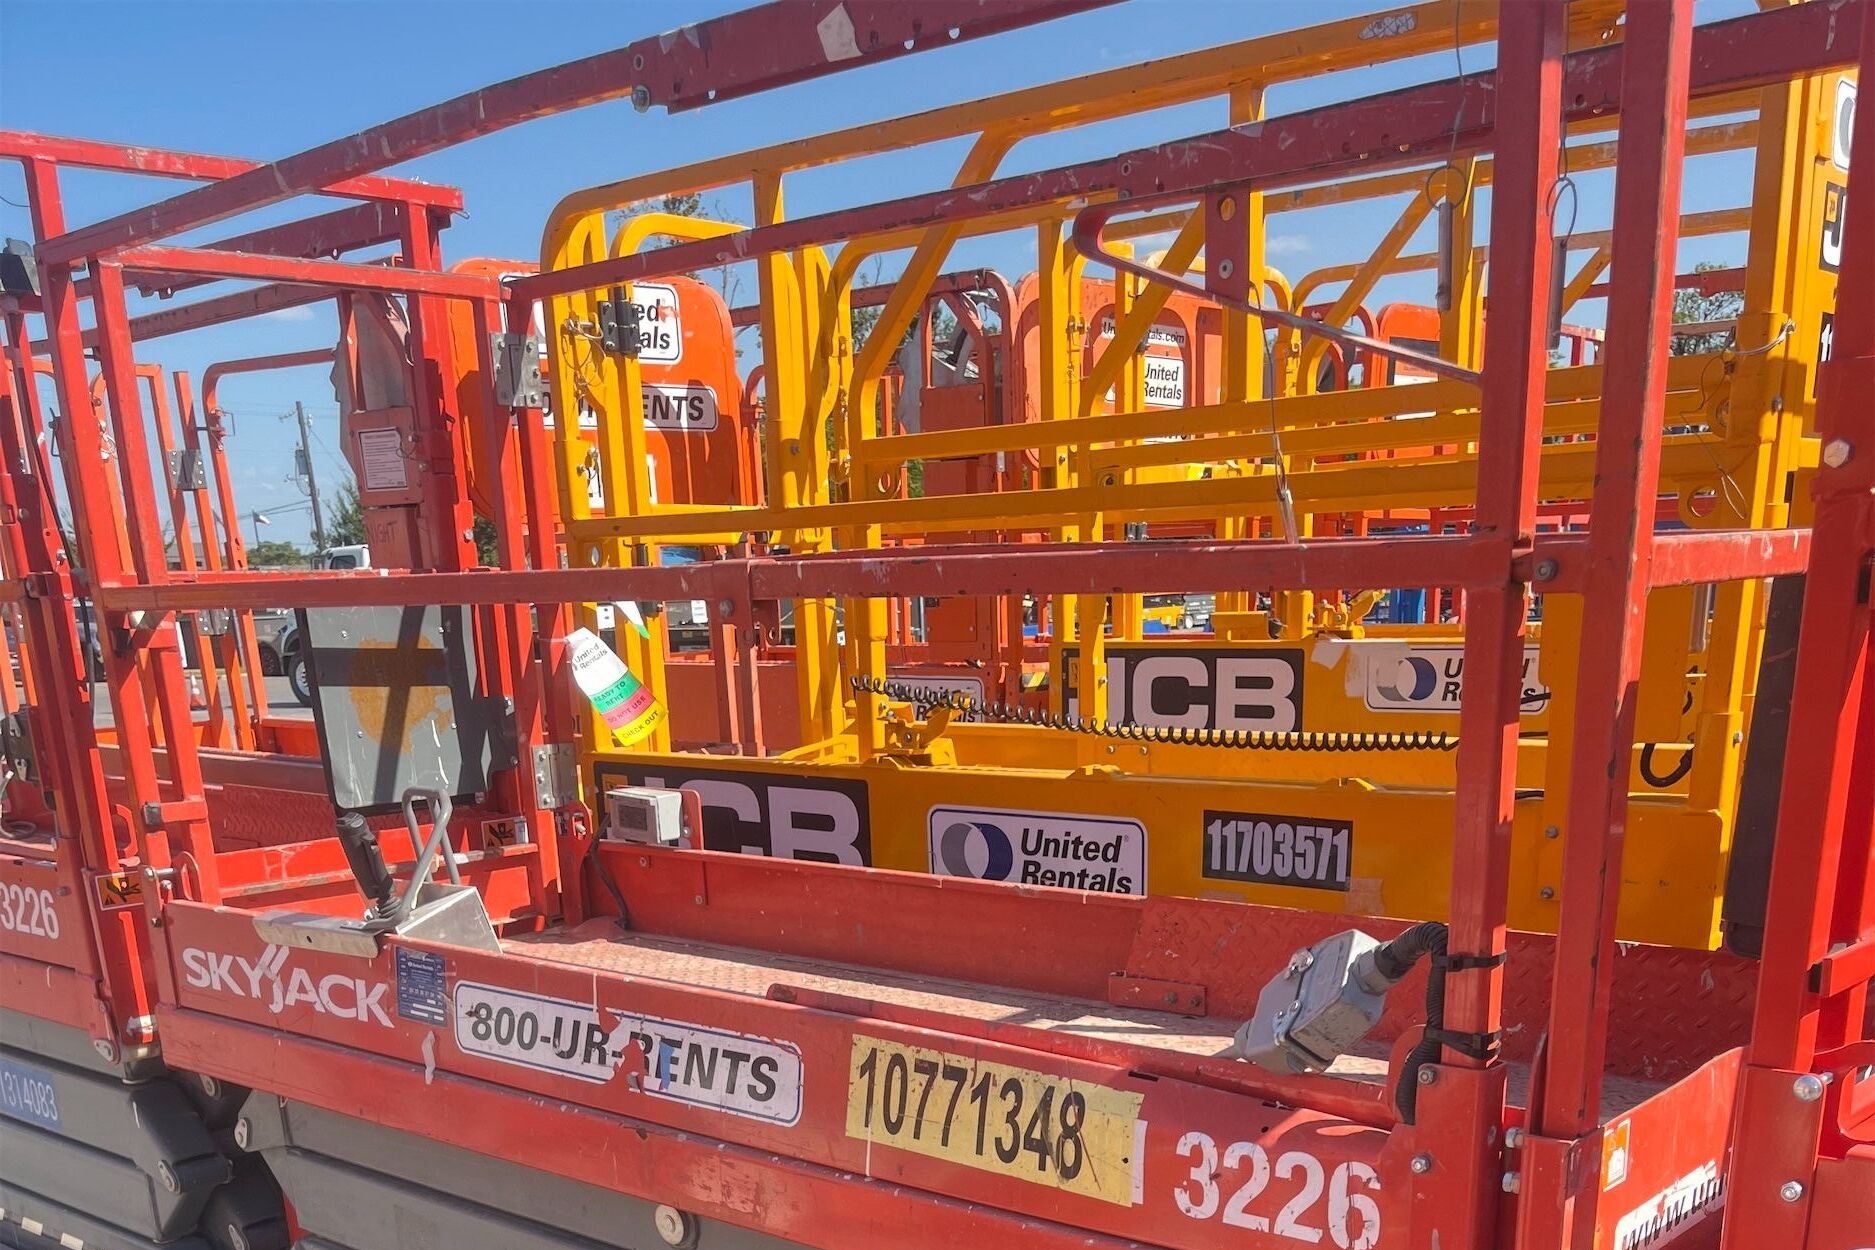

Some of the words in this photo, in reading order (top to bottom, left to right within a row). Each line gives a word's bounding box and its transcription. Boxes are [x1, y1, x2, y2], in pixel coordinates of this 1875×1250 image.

[1020, 828, 1121, 865] United
[1021, 860, 1132, 895] Rentals
[1206, 817, 1350, 883] 11703571
[182, 943, 394, 1028] SKYJACK
[859, 1047, 1086, 1179] 10771348
